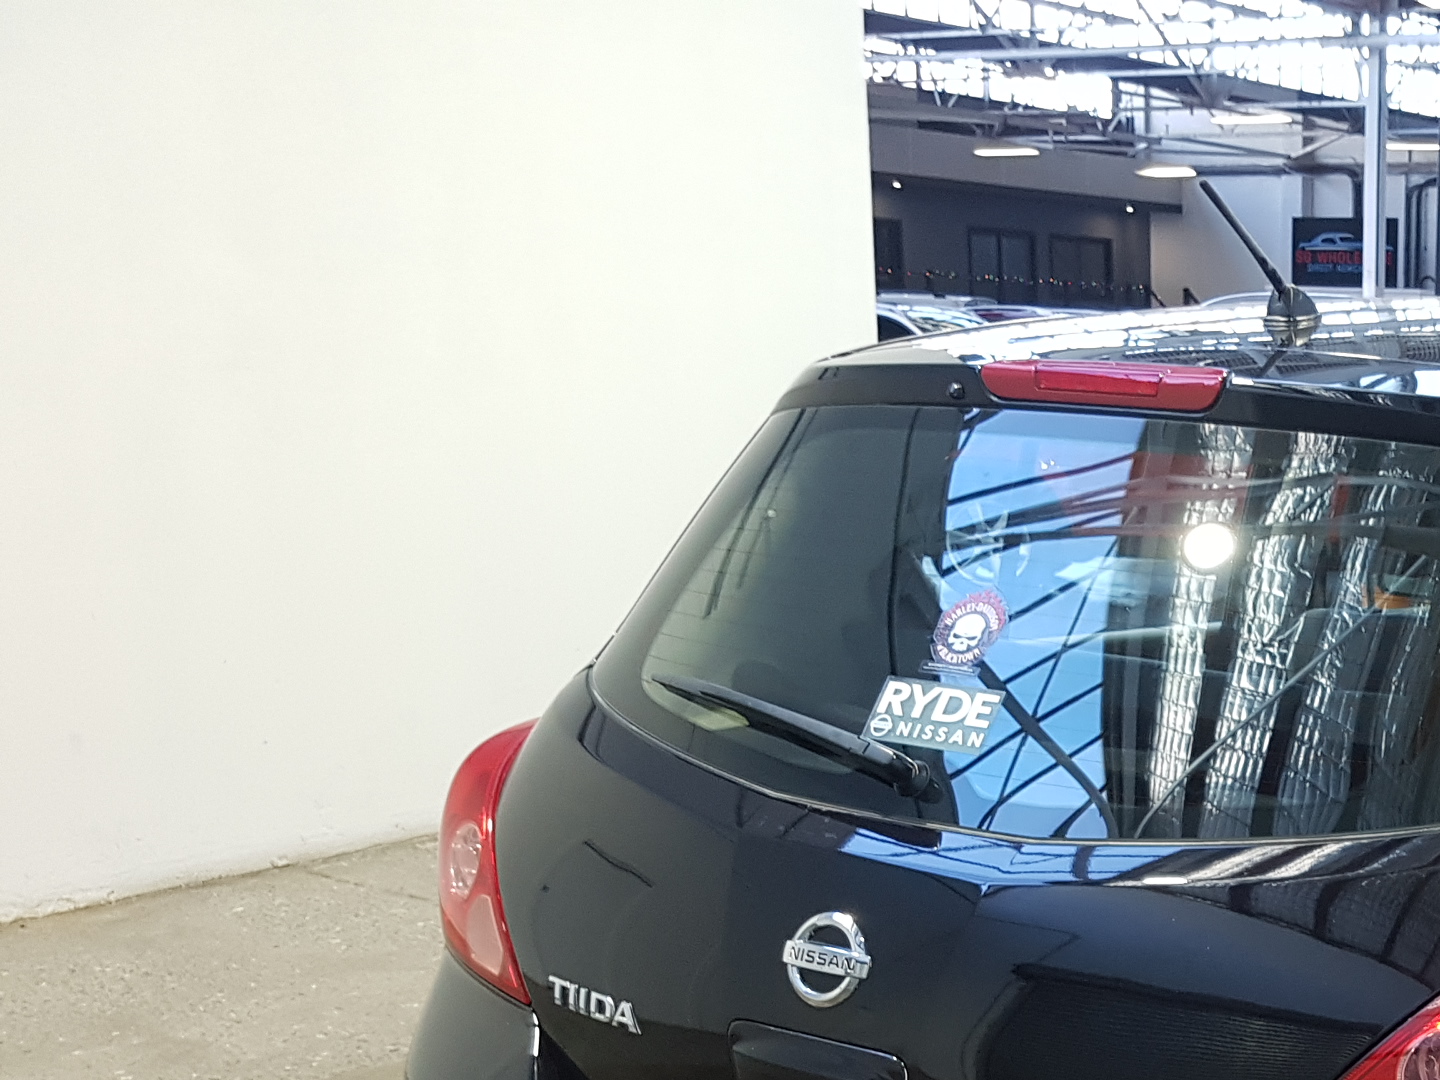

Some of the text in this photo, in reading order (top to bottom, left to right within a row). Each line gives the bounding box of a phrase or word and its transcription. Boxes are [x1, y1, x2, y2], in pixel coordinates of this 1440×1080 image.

[876, 680, 1001, 729] RYDE
[895, 720, 985, 748] NISSAN
[788, 945, 855, 972] NISSAN
[548, 975, 642, 1036] TIIDA
